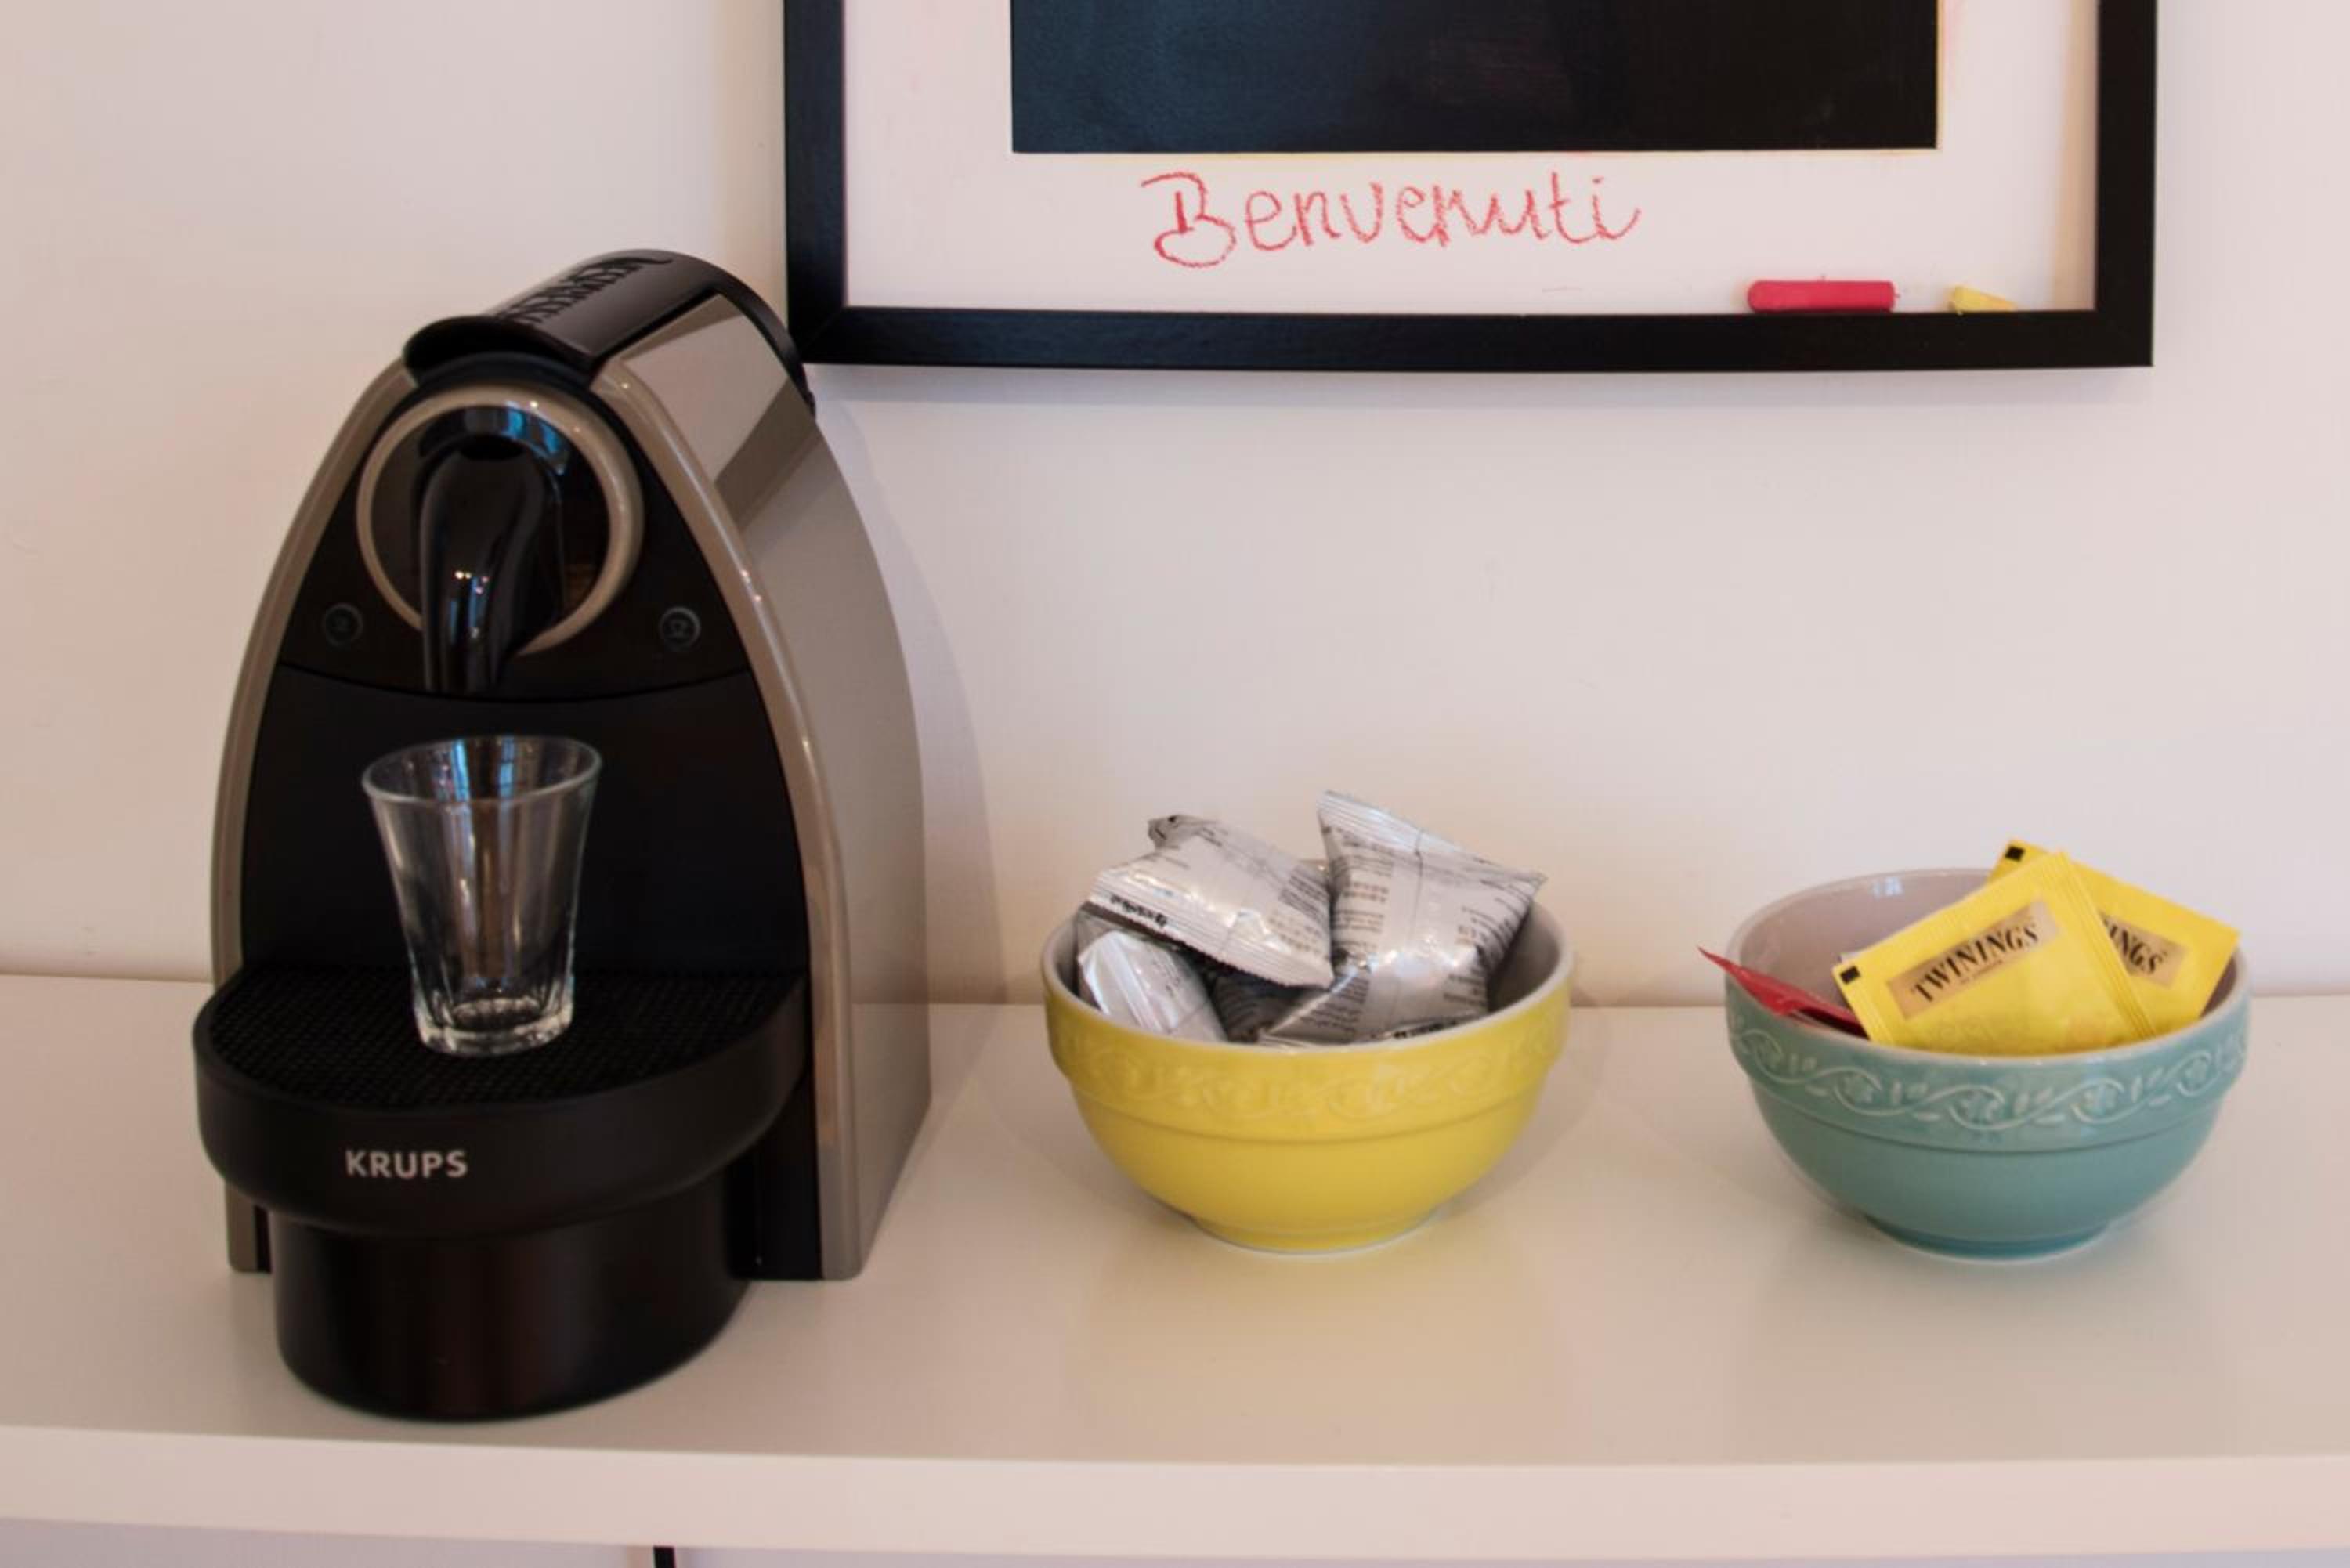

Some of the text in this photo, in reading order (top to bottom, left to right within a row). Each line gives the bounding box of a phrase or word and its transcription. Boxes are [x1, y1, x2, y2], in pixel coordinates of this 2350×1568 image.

[1141, 171, 1641, 268] Benvenuti
[1909, 923, 2038, 1002] TWININGS
[345, 1150, 468, 1178] KRUPS
